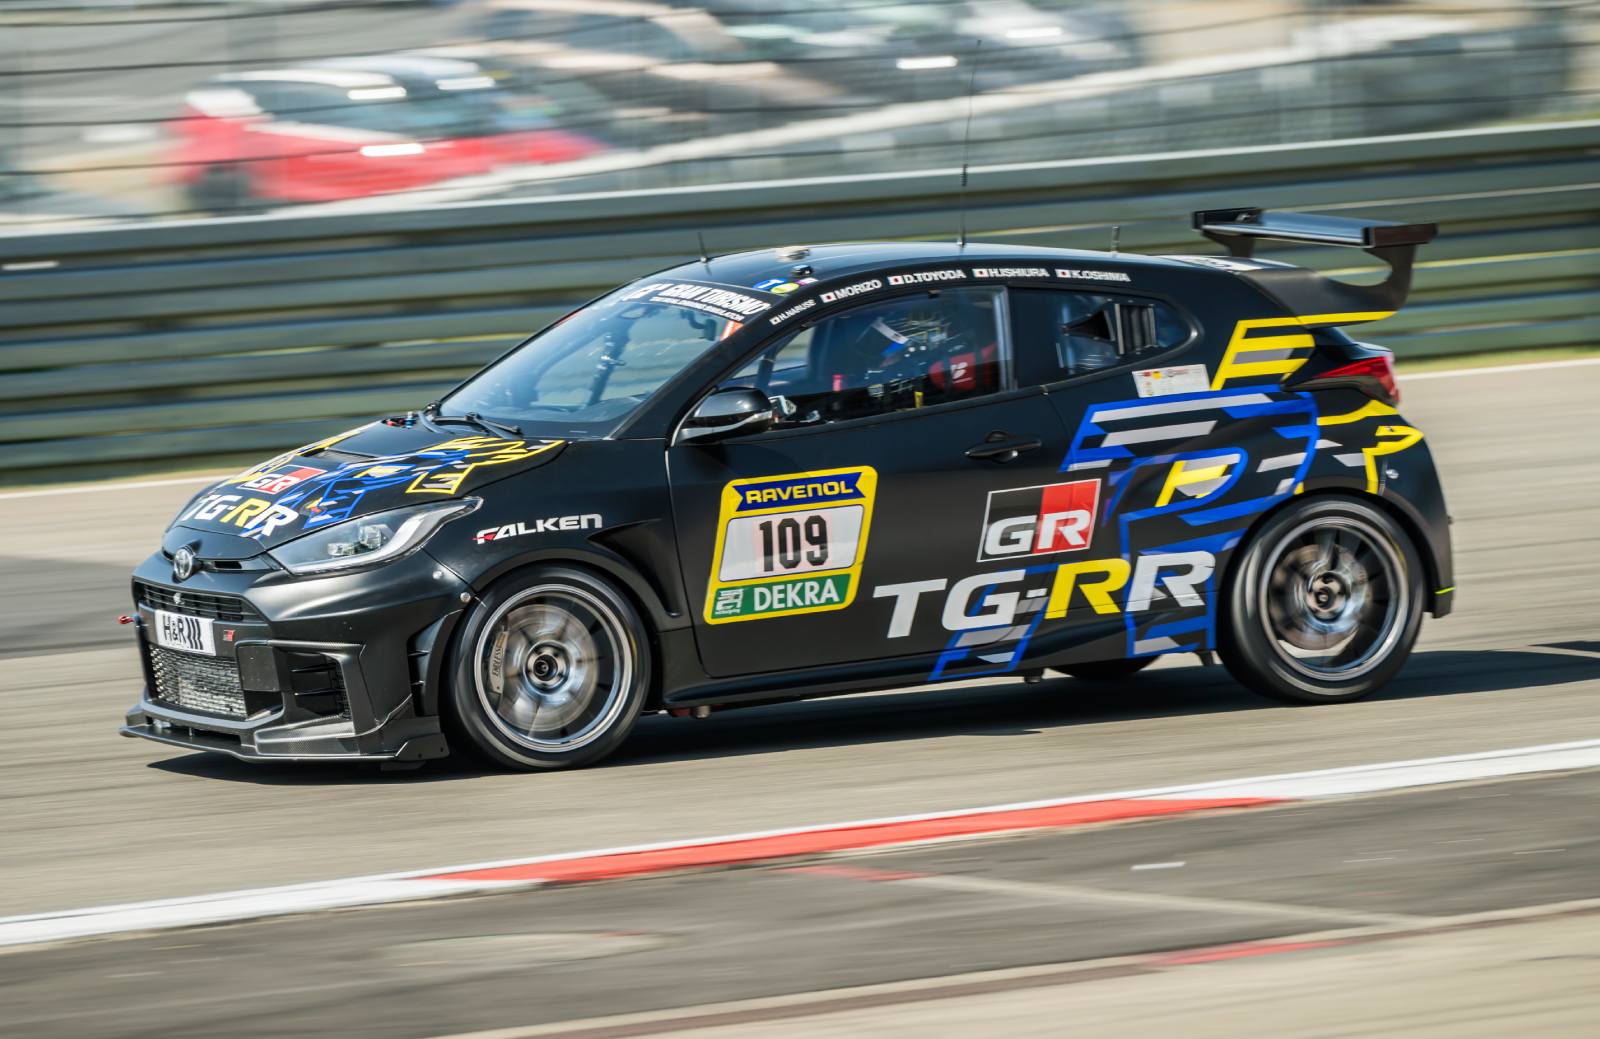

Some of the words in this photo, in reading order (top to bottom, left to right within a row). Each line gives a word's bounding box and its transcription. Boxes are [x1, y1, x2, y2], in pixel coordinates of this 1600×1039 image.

[834, 279, 882, 299] MORIZO
[905, 269, 968, 284] D.TOYODA
[244, 473, 301, 492] GR
[746, 481, 853, 504] RAVENOL
[473, 513, 602, 544] FALKEN
[759, 515, 829, 572] 109
[984, 509, 1091, 555] GR
[754, 579, 840, 611] DEKRA
[873, 551, 1216, 638] TG-RR
[162, 614, 187, 644] H&R
